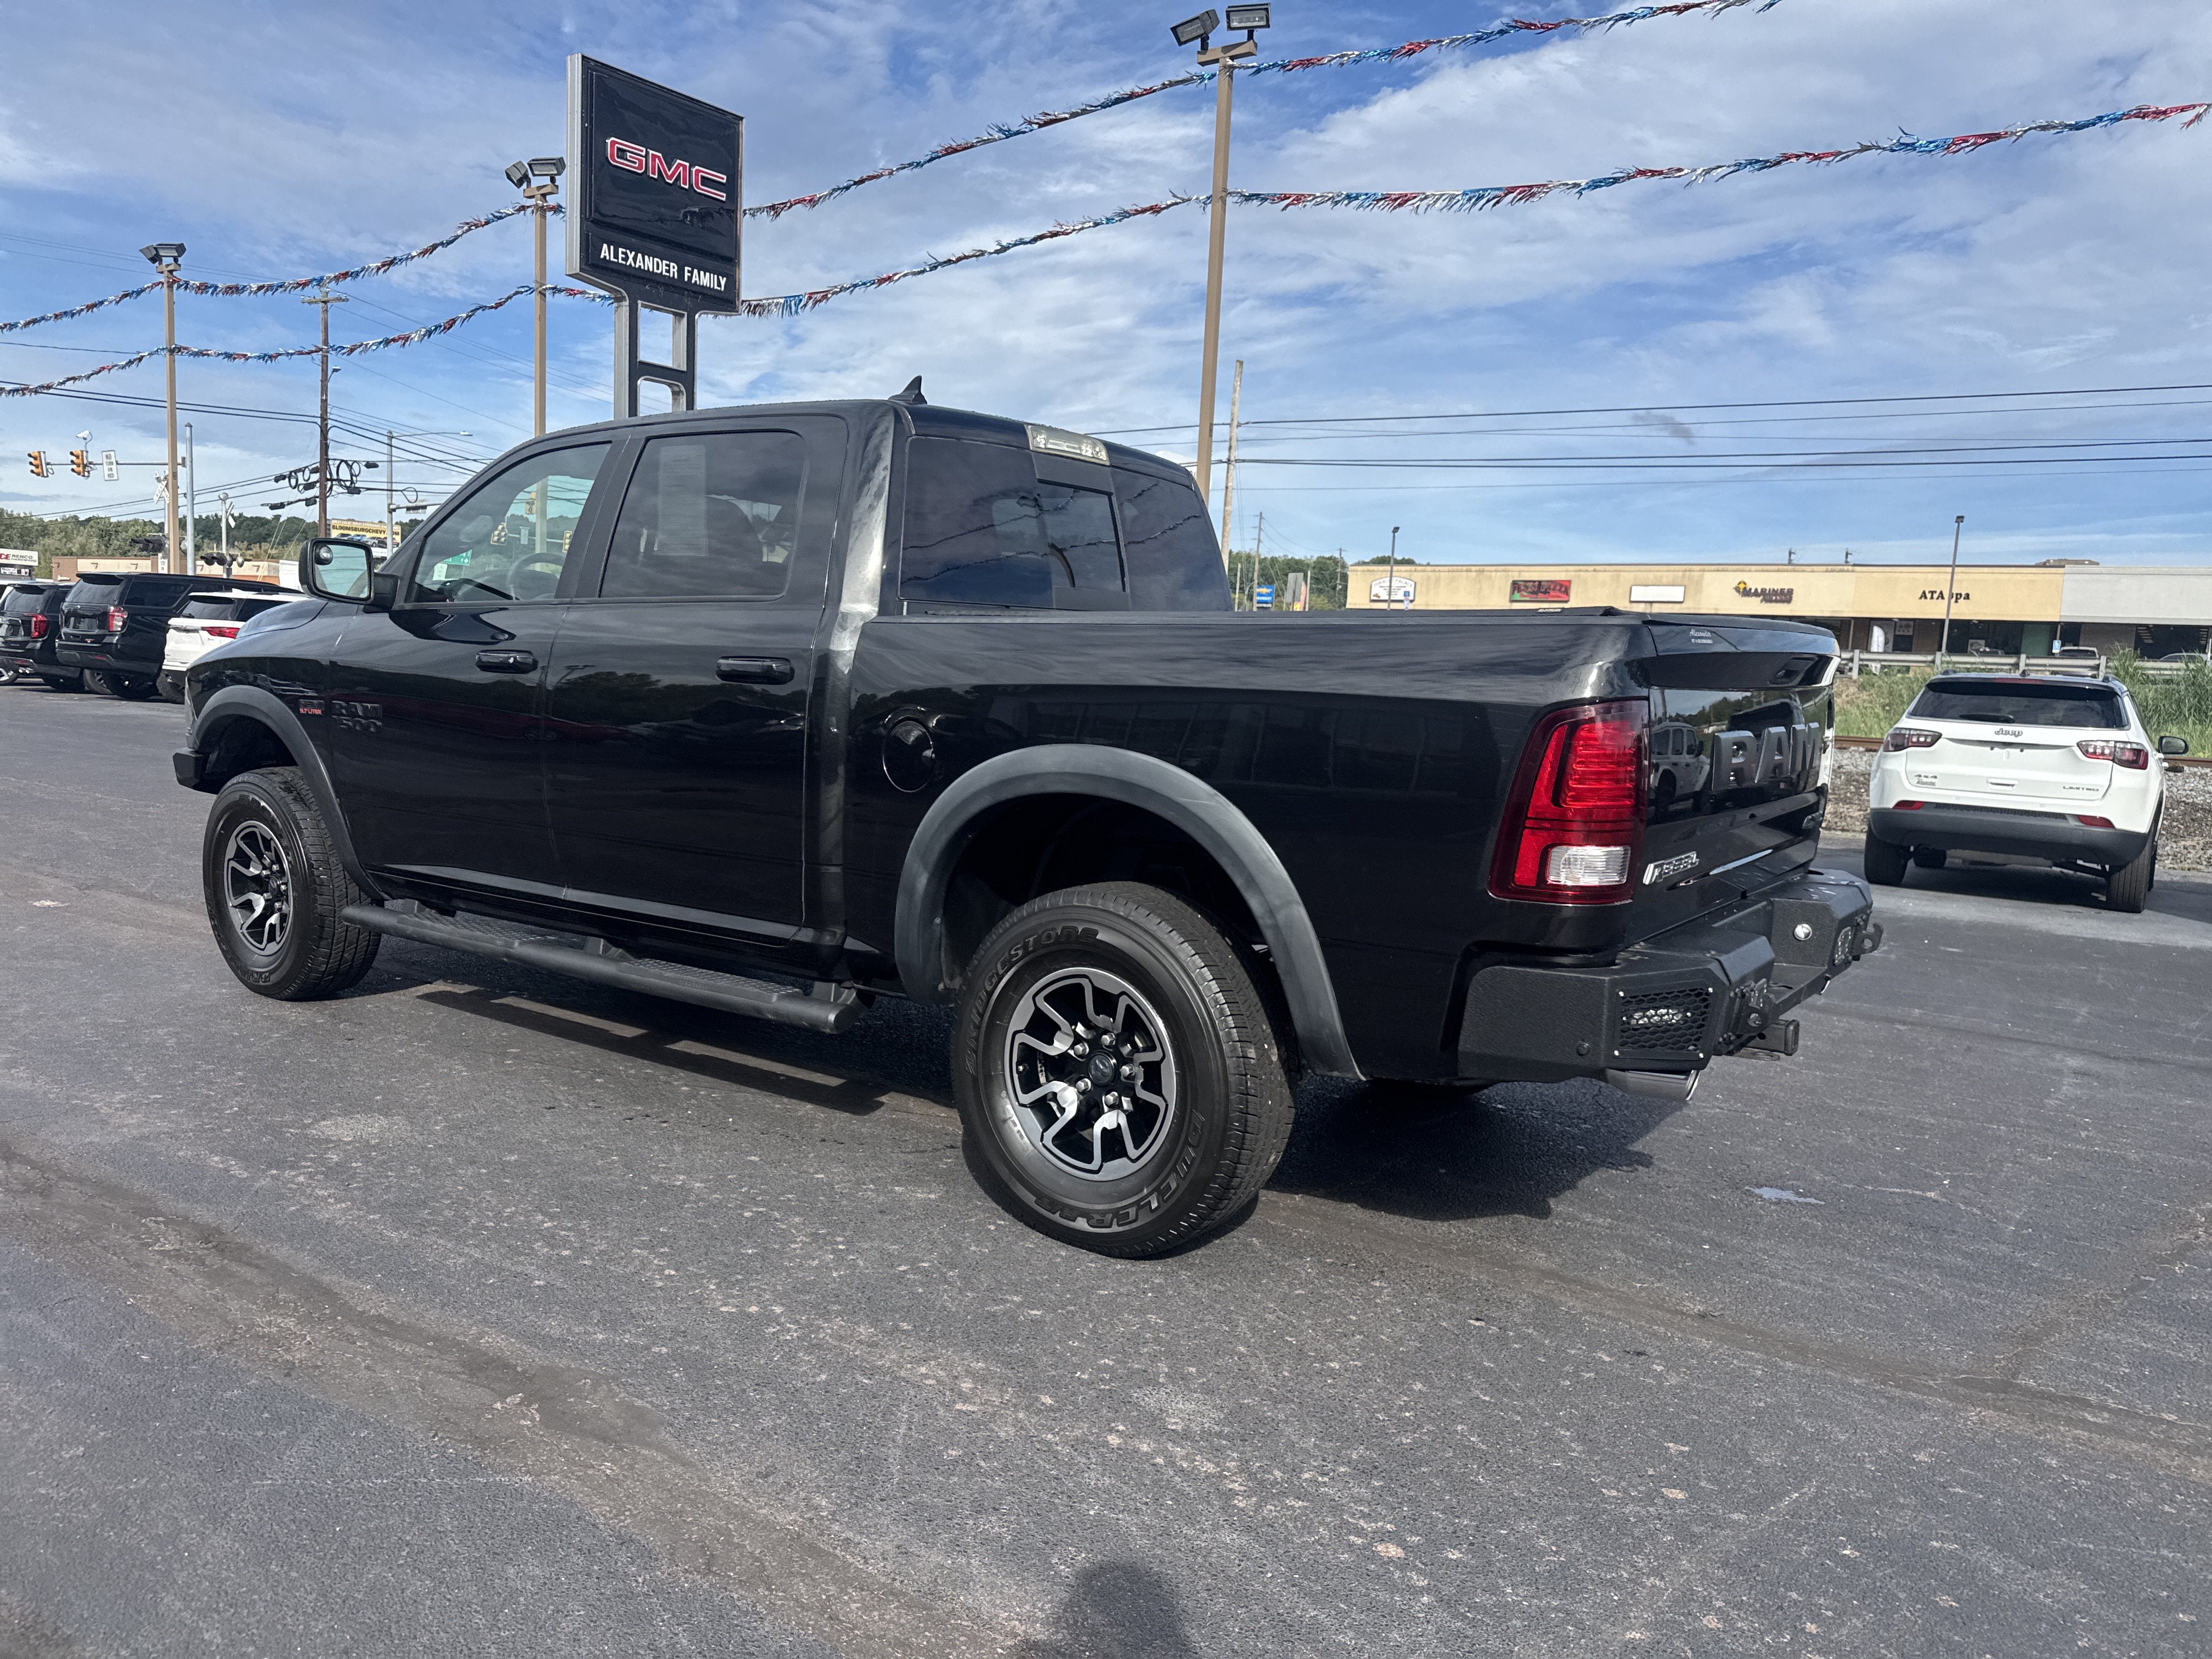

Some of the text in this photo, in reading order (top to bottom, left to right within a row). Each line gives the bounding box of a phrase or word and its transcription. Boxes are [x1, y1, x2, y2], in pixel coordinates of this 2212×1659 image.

[606, 137, 727, 201] GMC
[600, 243, 727, 291] ALEXANDER FAMILY
[332, 525, 399, 535] BLOOMSBURGCHEVYOM
[1741, 588, 1793, 597] MARINER
[1918, 590, 1945, 600] ATA
[1995, 728, 2023, 737] Jeep
[1711, 722, 1822, 791] RAM
[965, 926, 1099, 1075] BRIDGESTONE
